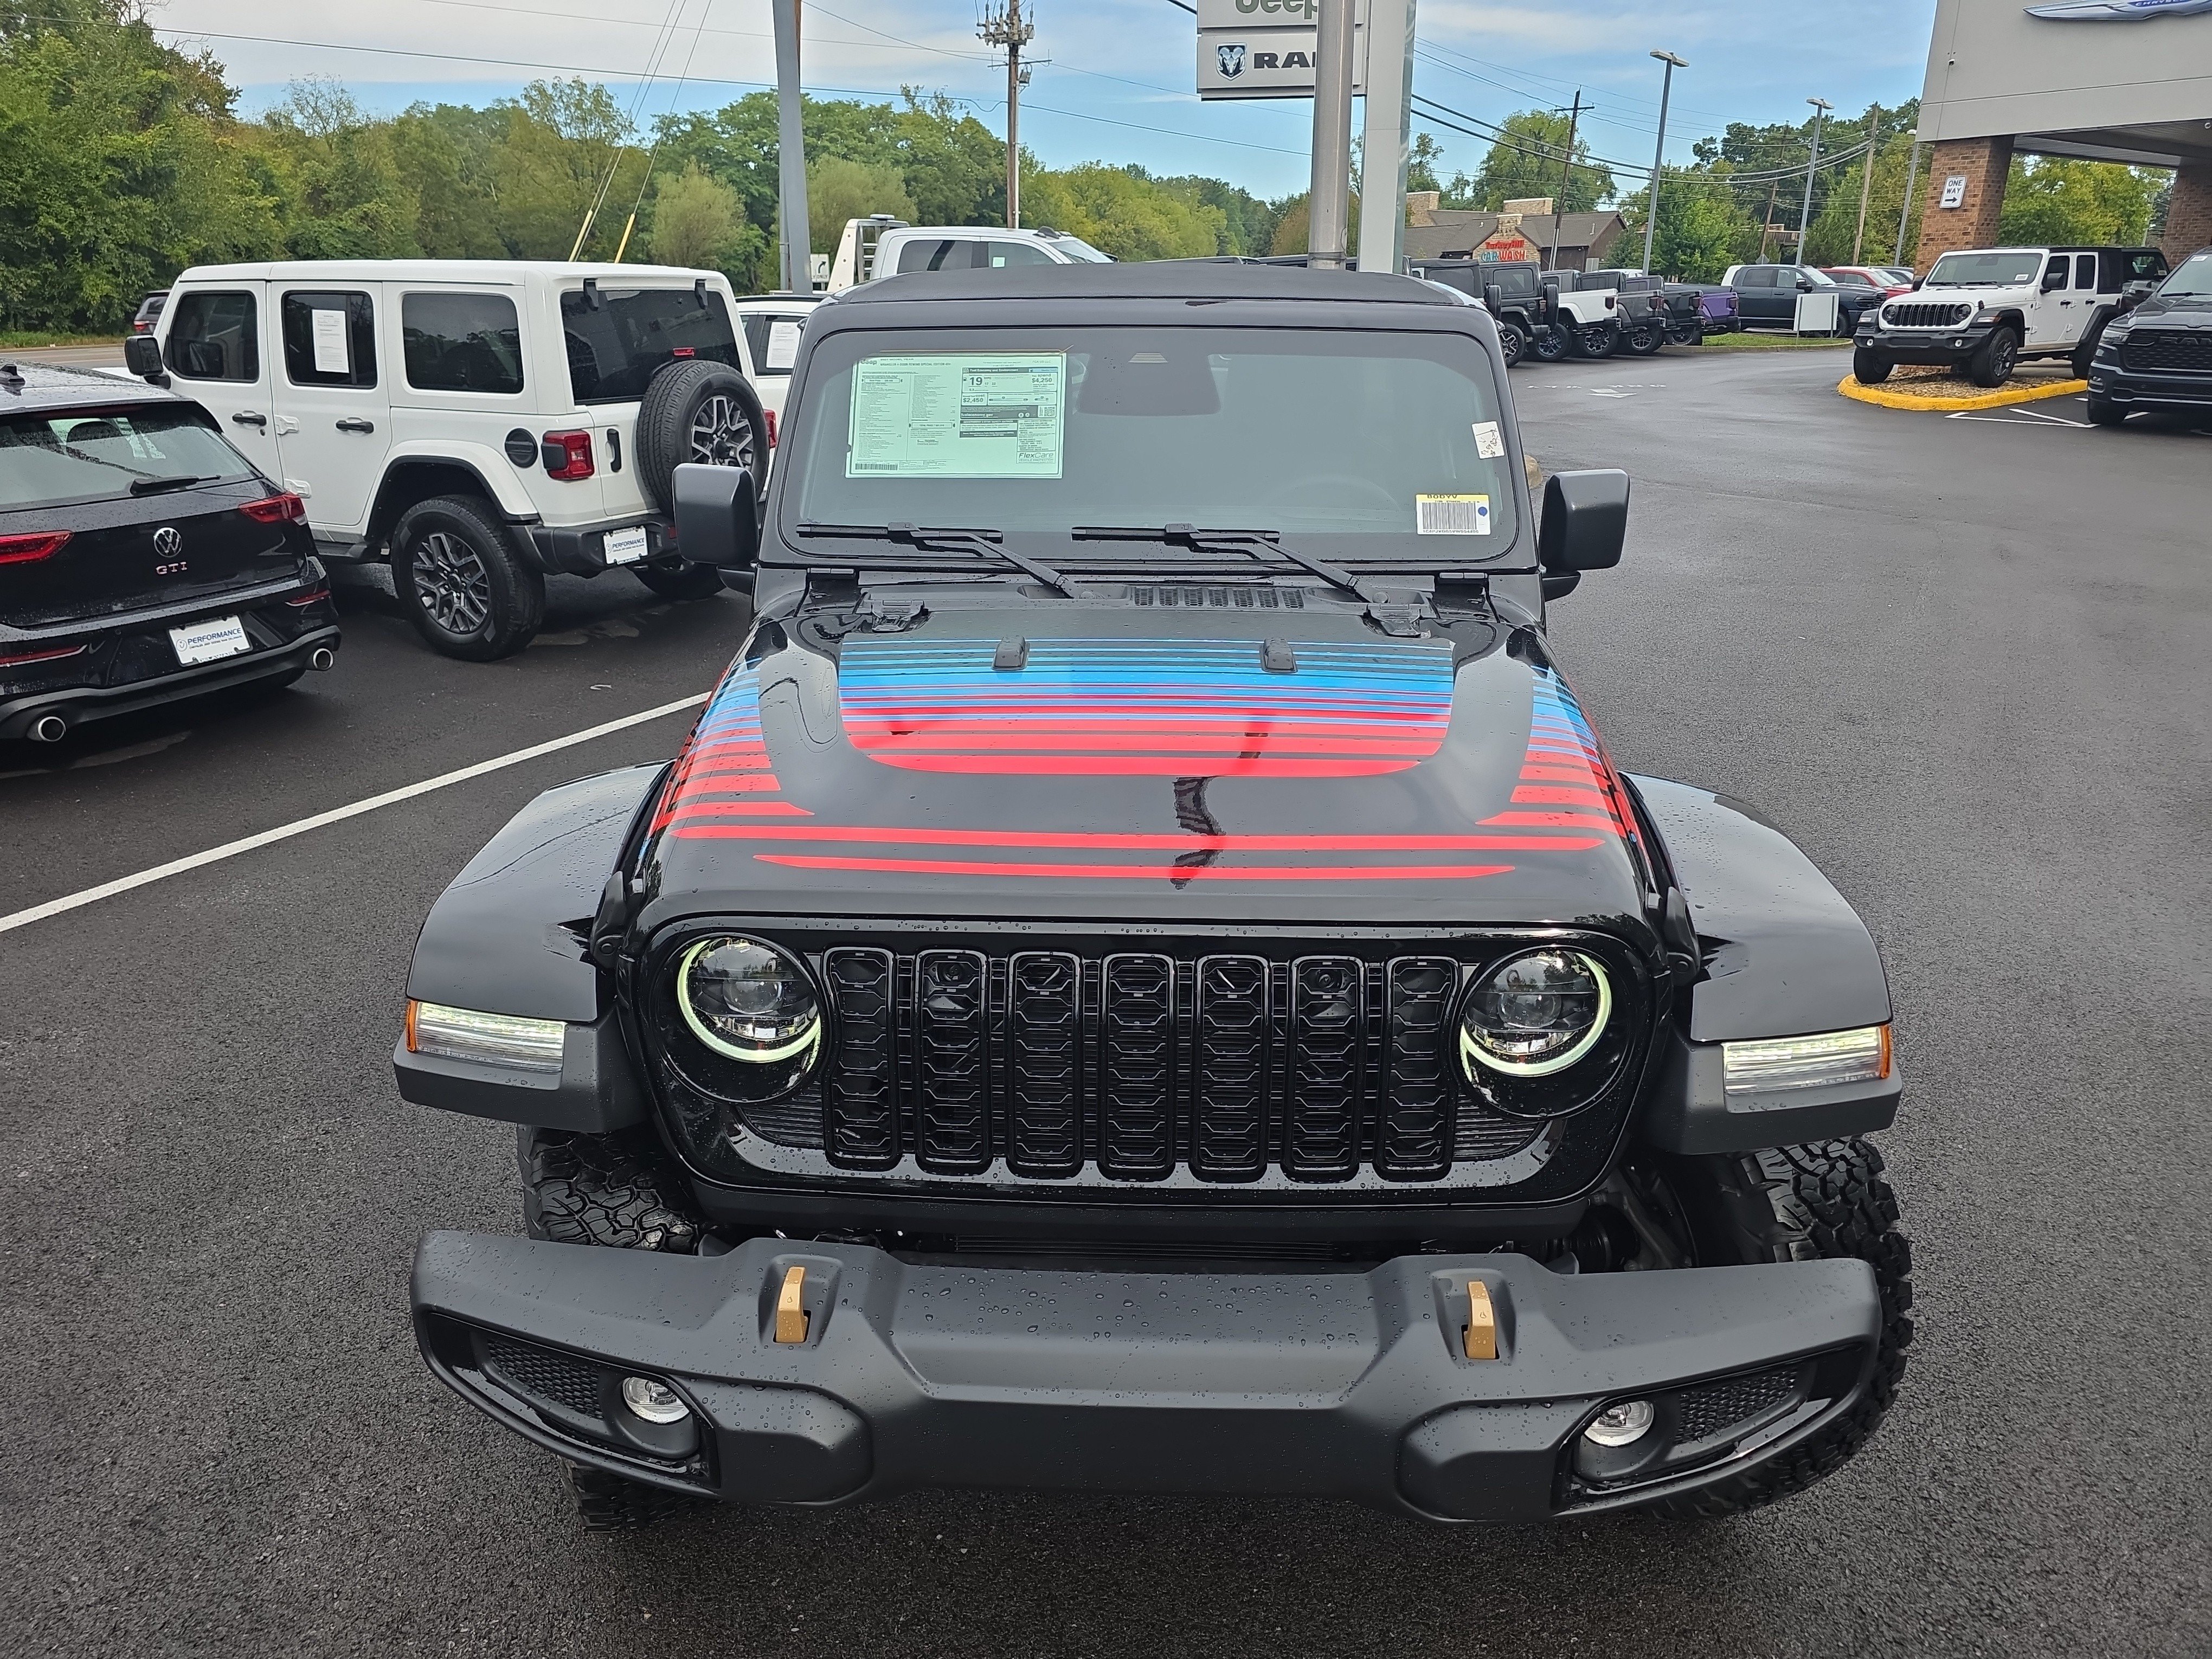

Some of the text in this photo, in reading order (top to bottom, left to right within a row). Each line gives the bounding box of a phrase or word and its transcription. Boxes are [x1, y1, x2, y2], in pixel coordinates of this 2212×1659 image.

[1253, 52, 1316, 69] RA
[1481, 250, 1527, 262] CAR WASH
[969, 377, 983, 385] 19
[612, 537, 645, 549] PERFORMANCE
[156, 561, 188, 575] GTI
[188, 627, 241, 645] PERFORMANCE
